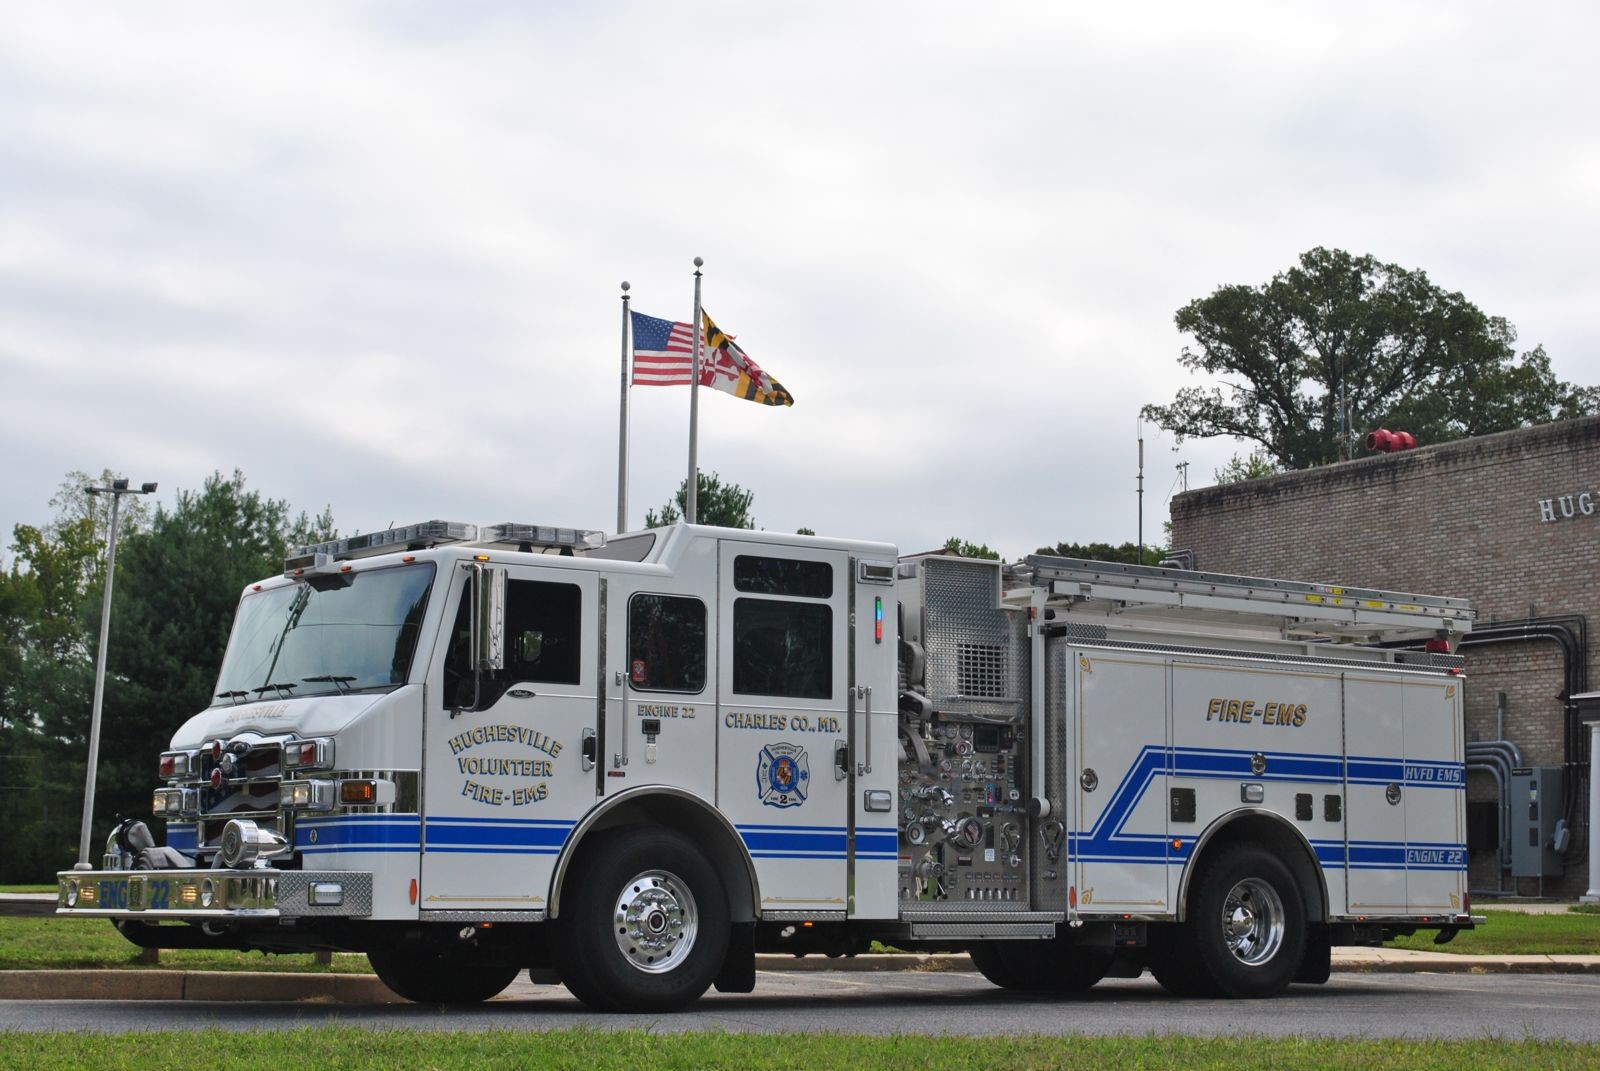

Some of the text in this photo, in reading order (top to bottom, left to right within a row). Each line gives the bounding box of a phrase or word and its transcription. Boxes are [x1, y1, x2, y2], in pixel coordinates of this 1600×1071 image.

[1538, 491, 1600, 522] HUG
[637, 704, 696, 719] ENGINE 22
[725, 711, 787, 732] CHARLES
[817, 716, 841, 733] MD.
[1206, 698, 1308, 727] FIRE-EMS
[448, 724, 563, 758] HUGHESVILLE
[457, 757, 554, 777] VOLUNTEER
[1406, 767, 1460, 782] HVFD EMS
[779, 794, 788, 804] 2
[1407, 850, 1462, 864] ENGINE 22
[151, 880, 169, 909] 22
